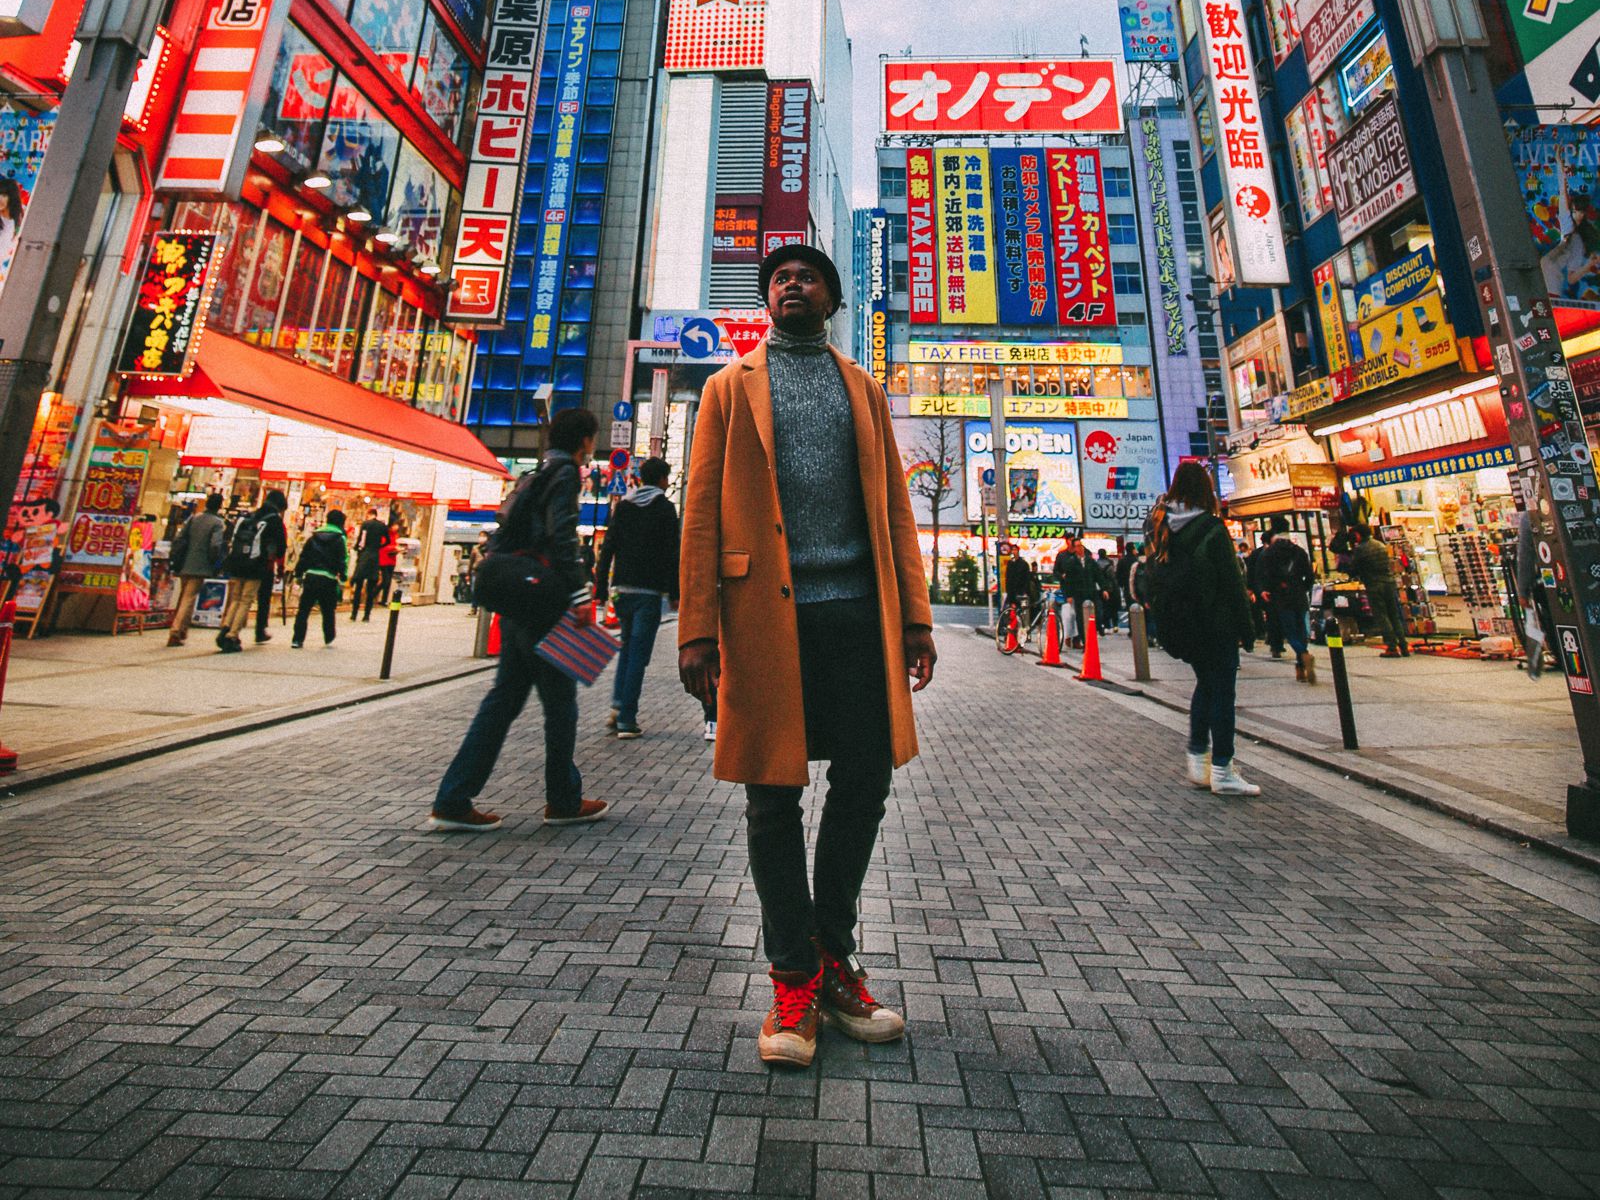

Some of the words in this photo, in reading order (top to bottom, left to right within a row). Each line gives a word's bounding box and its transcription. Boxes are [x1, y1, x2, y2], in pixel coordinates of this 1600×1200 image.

[889, 63, 1111, 122] オノデン
[769, 88, 783, 133] Flagship
[781, 88, 808, 139] Duty
[769, 137, 782, 168] Store
[1344, 130, 1371, 158] English
[1346, 128, 1403, 183] COMPUTER
[781, 144, 808, 194] Free
[909, 154, 931, 198] 免税
[1352, 187, 1363, 206] &
[1362, 154, 1410, 200] MOBILE
[546, 211, 564, 222] 4F
[911, 202, 932, 248] TAX
[1001, 166, 1024, 293] お見積り無料です
[872, 217, 886, 301] Panasonic
[1316, 264, 1330, 283] 2F
[1385, 253, 1423, 284] DISCOUNT
[912, 251, 934, 313] FREE
[1385, 267, 1432, 298] COMPUTERS
[1066, 303, 1104, 321] 4F
[1360, 302, 1372, 320] 2F
[732, 330, 760, 341] 止まれ
[873, 311, 887, 385] ONODEN
[919, 347, 952, 360] TAX
[959, 347, 1004, 360] FREE
[1010, 347, 1050, 361] 免税店
[1365, 364, 1399, 389] MOBILES
[920, 400, 957, 413] テレビ
[1008, 402, 1059, 414] エアコン
[1381, 396, 1488, 457] TAKARADA
[89, 525, 125, 537] 500
[87, 541, 125, 555] OFF
